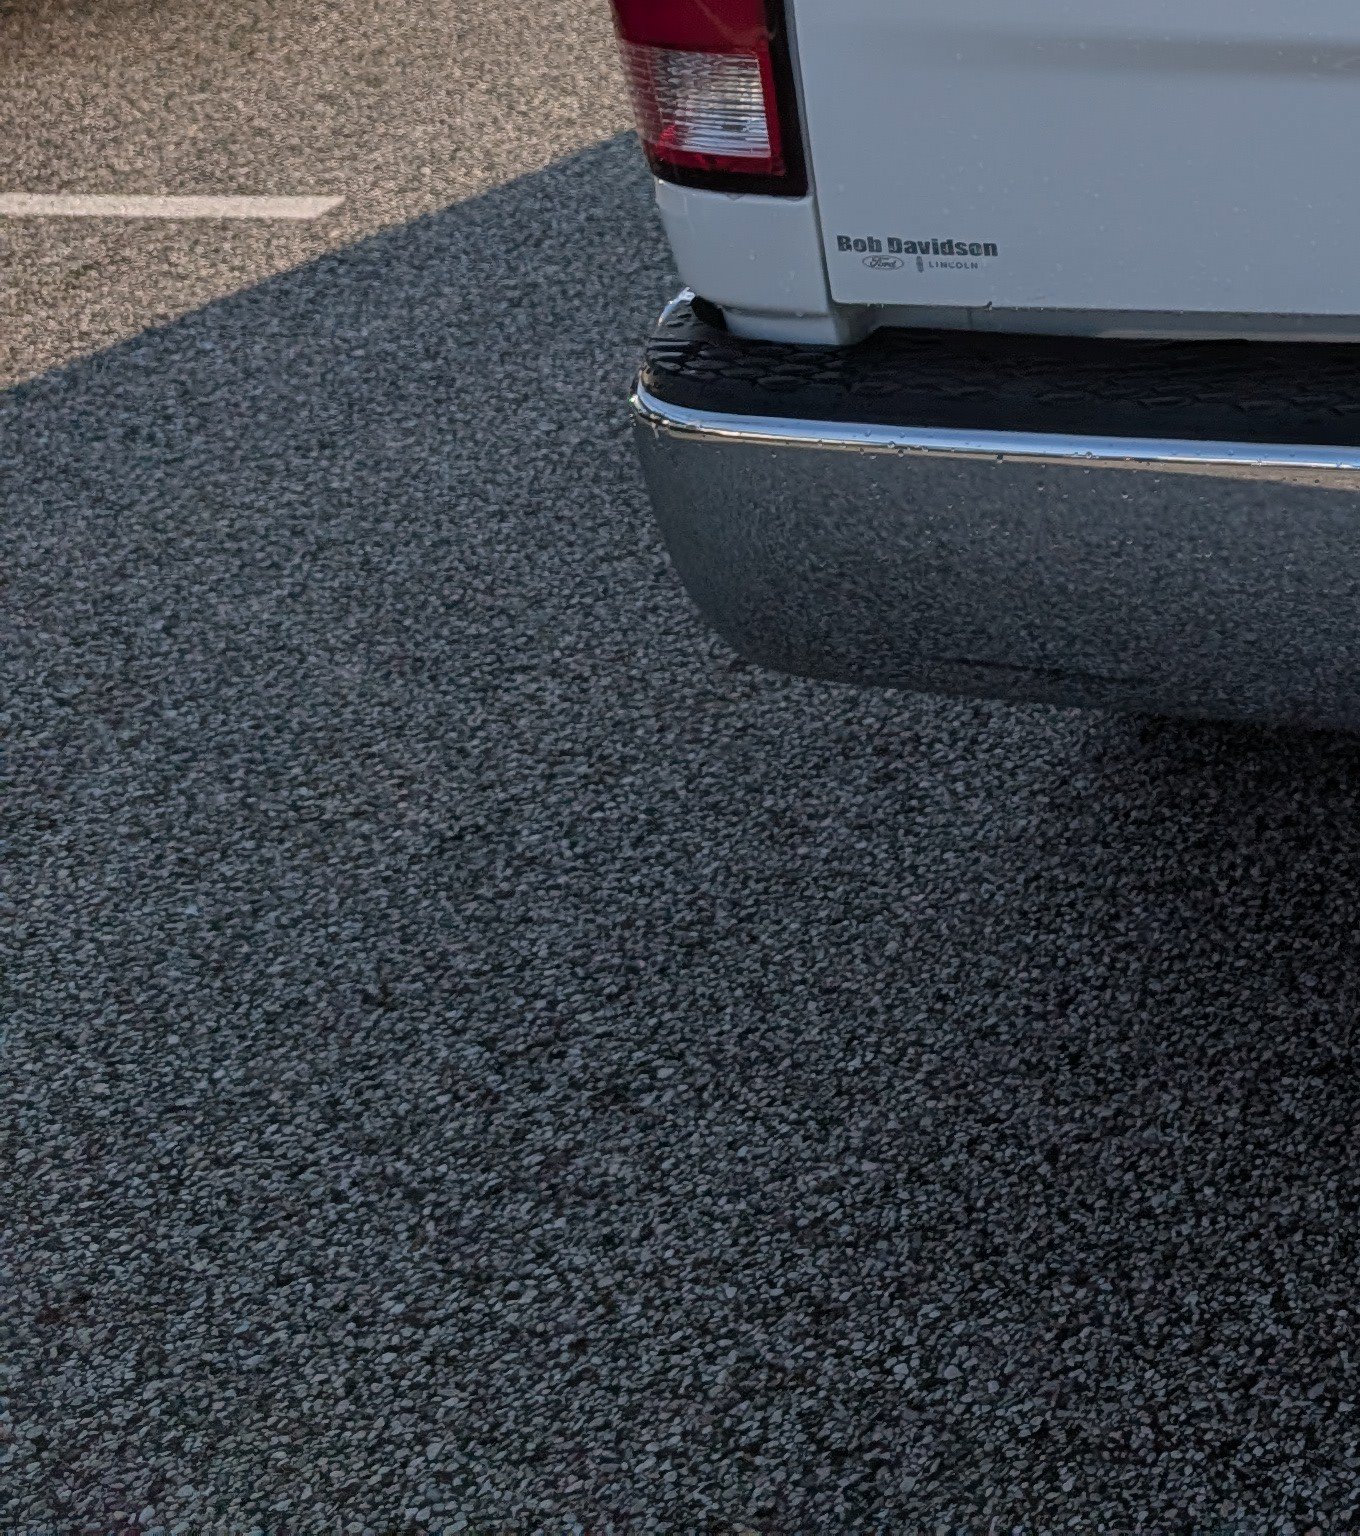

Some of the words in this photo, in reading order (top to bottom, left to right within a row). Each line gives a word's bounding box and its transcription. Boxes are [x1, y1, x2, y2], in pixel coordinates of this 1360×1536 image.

[836, 235, 882, 253] Bob
[887, 236, 999, 257] Davidson
[928, 261, 979, 270] LINCOLN
